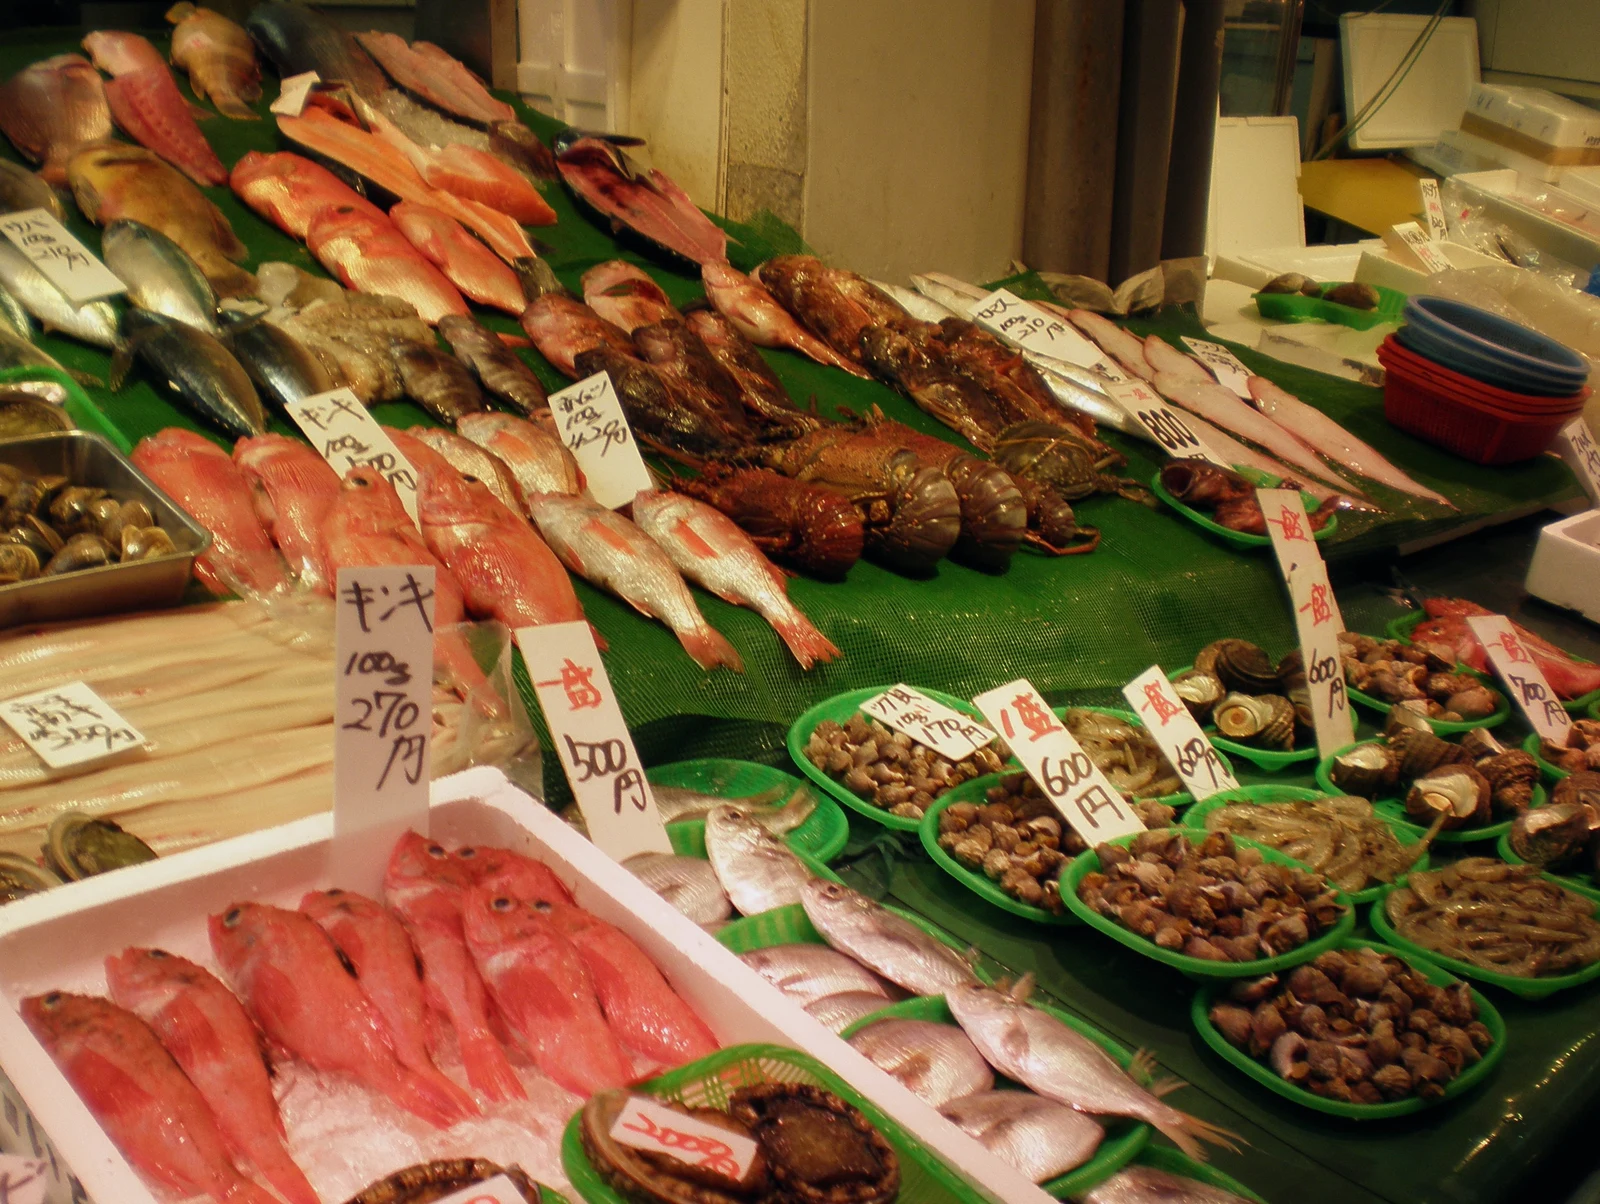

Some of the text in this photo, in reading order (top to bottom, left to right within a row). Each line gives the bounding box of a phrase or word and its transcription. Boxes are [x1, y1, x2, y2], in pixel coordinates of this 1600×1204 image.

[1137, 407, 1200, 450] 800
[341, 573, 434, 634] キンキ
[344, 651, 412, 686] 100g
[1309, 648, 1337, 684] 600
[1507, 673, 1547, 707] 700
[342, 690, 420, 738] 270
[375, 733, 426, 792] 円
[563, 733, 627, 783] 500
[1041, 751, 1093, 797] 600
[613, 768, 647, 815] 円
[1074, 784, 1126, 829] 円
